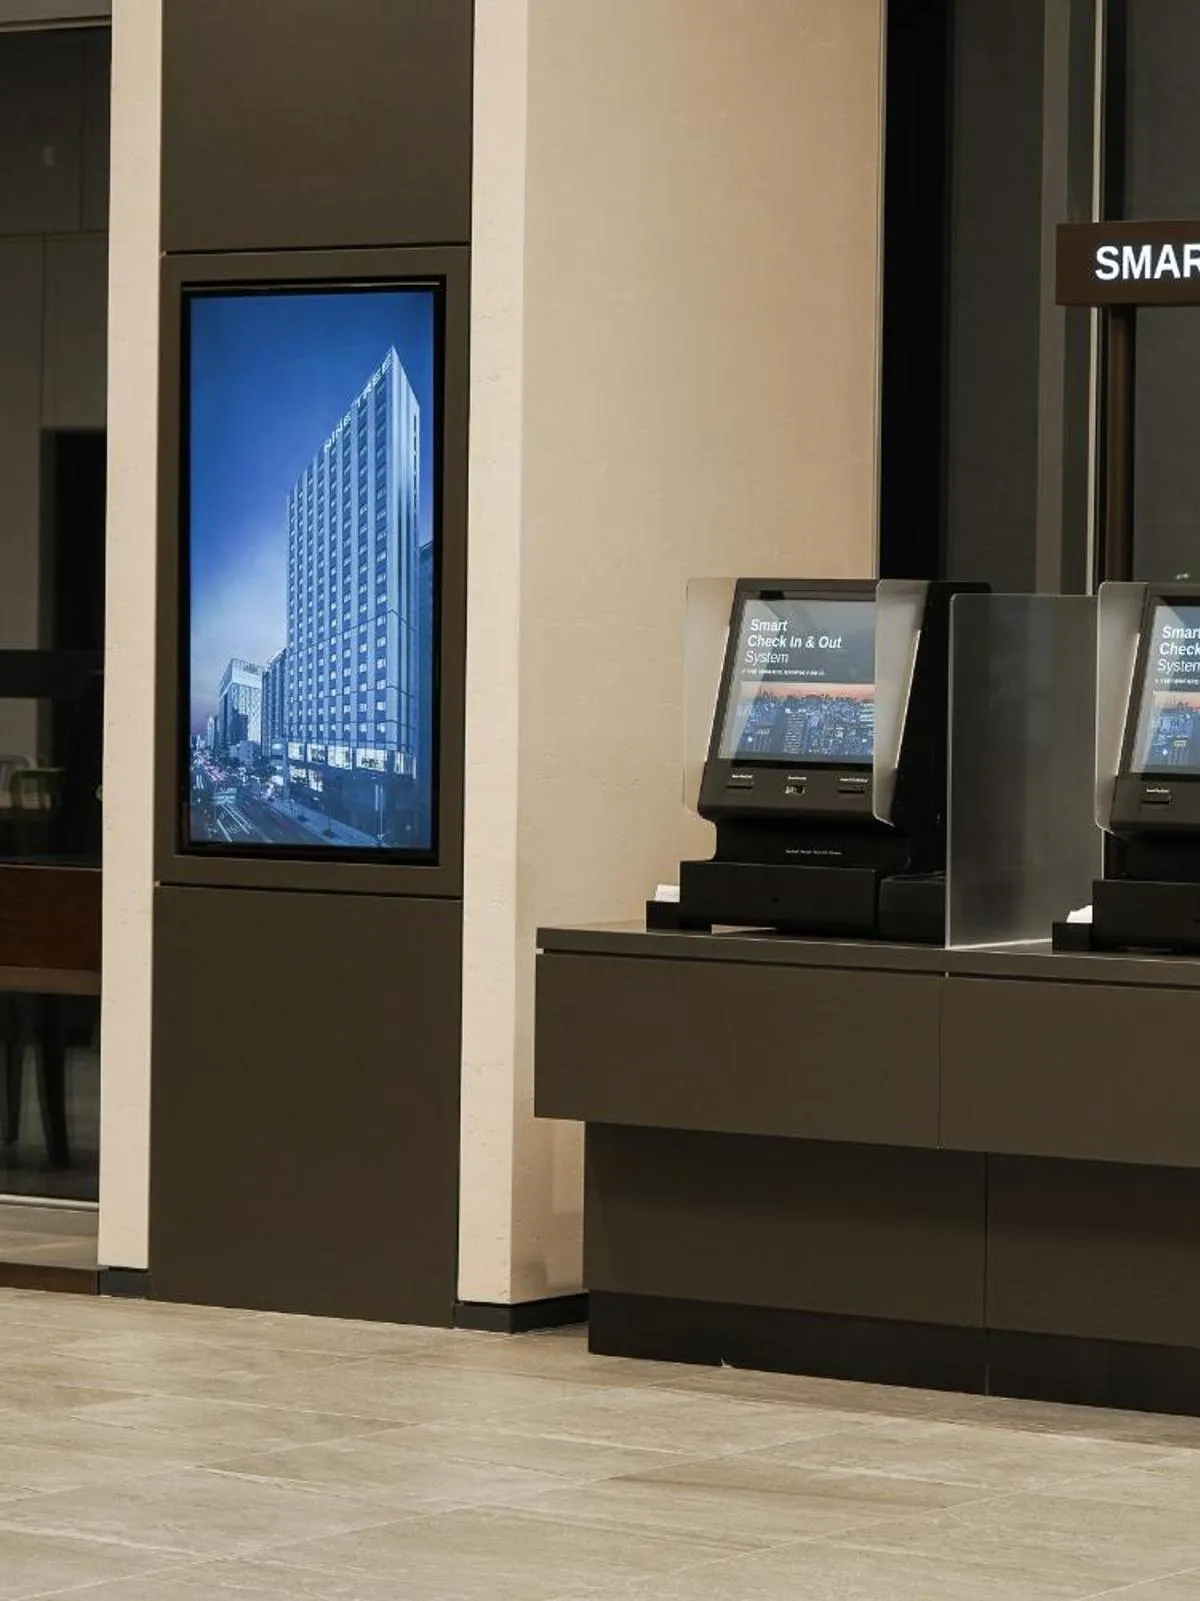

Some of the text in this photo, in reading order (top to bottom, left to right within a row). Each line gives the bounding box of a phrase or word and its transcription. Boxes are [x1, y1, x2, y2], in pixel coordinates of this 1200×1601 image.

[750, 618, 788, 631] Smart
[747, 634, 842, 649] Check In & Out
[744, 650, 789, 666] System
